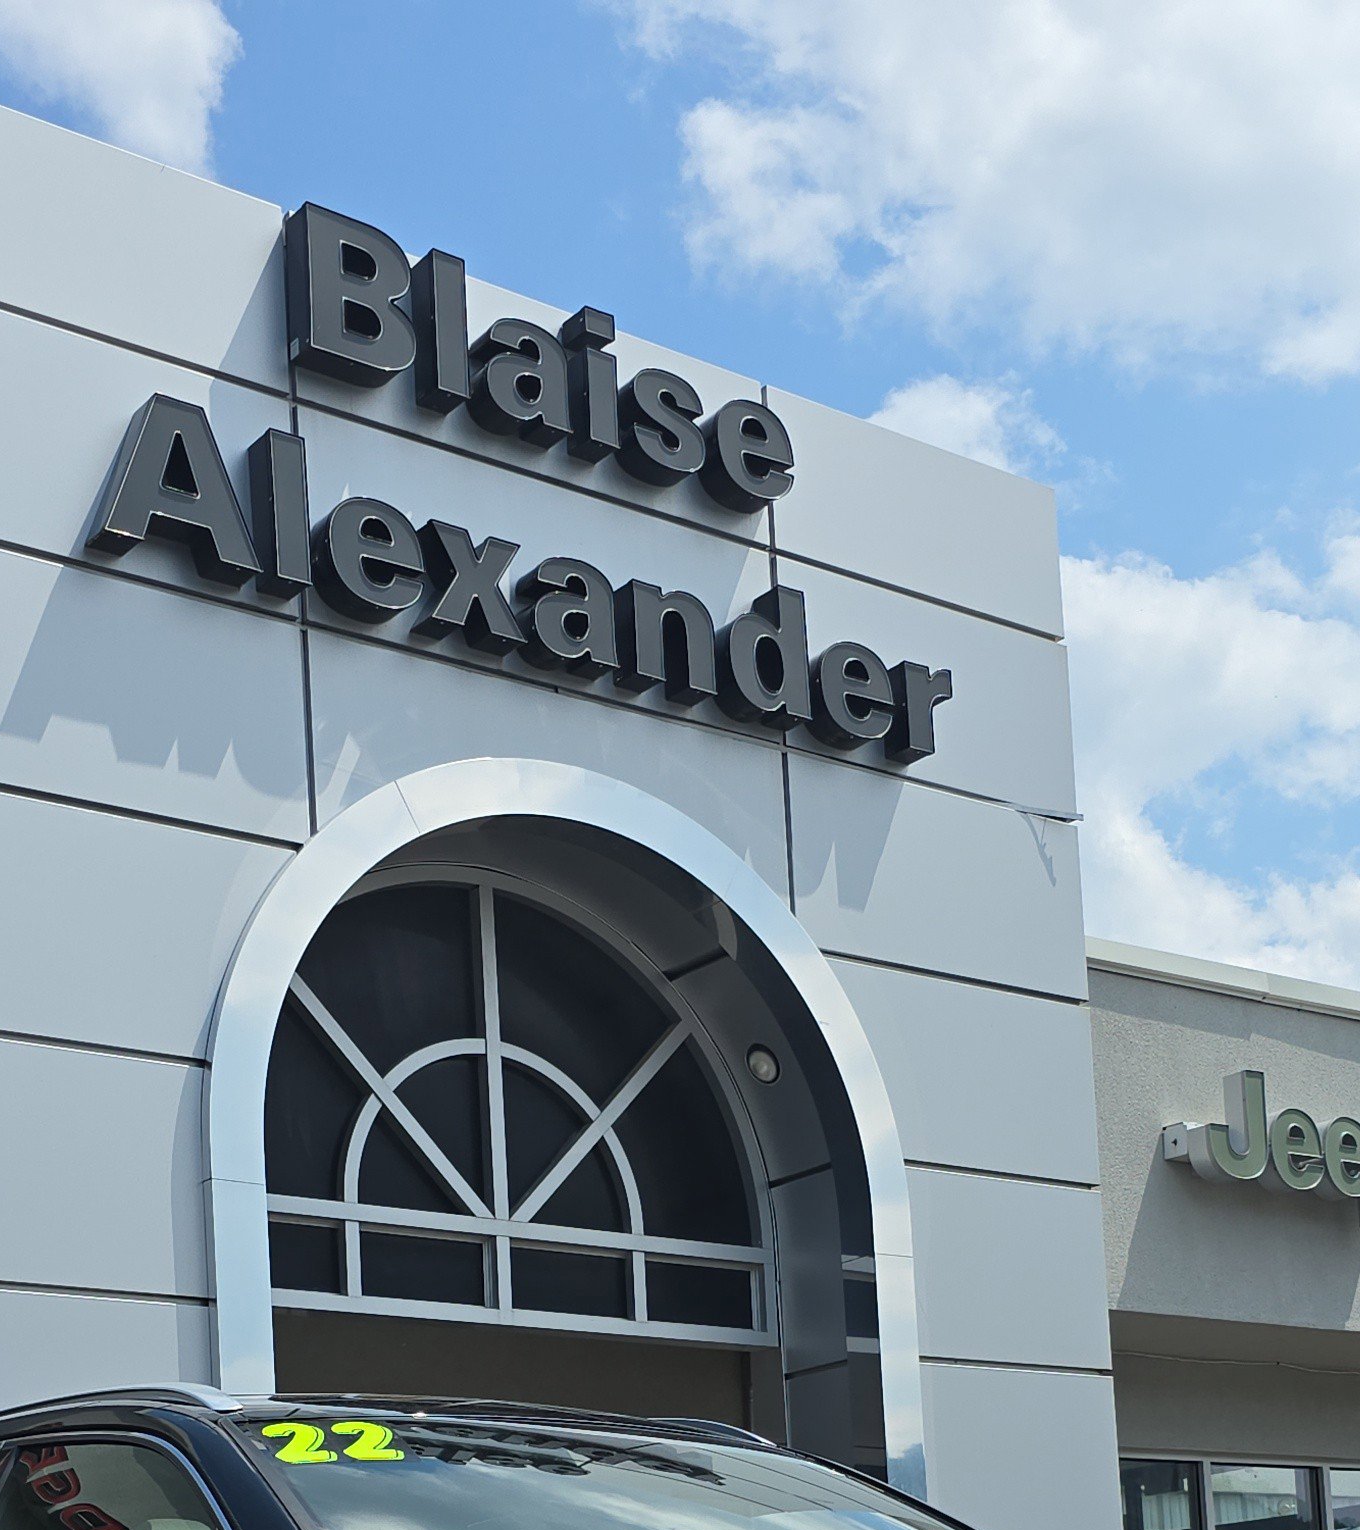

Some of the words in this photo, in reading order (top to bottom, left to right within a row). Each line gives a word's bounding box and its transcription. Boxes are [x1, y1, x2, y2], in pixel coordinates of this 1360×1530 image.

[285, 201, 796, 515] Blaise
[86, 392, 954, 766] Alexander
[261, 1421, 405, 1465] 22
